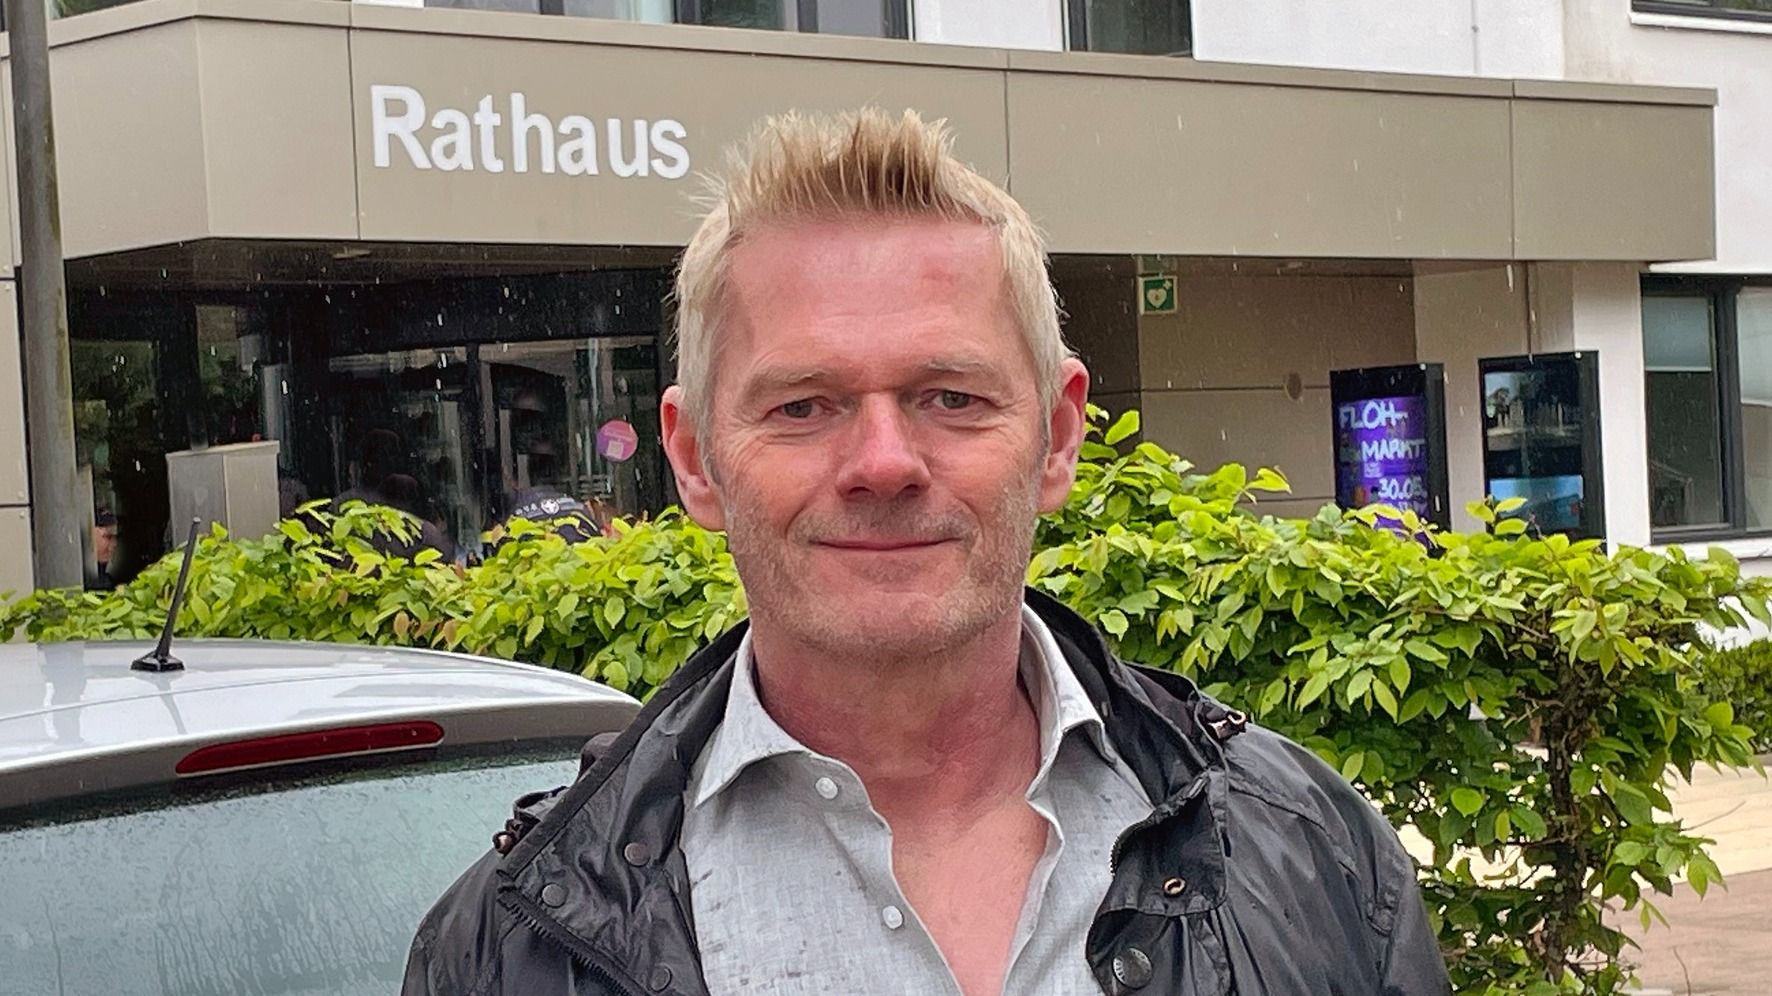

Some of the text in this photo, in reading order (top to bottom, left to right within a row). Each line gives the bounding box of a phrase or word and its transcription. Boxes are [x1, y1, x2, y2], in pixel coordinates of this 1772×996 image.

[370, 84, 690, 180] Rathaus
[1339, 400, 1408, 430] FLOH-
[1361, 438, 1425, 461] MARKT
